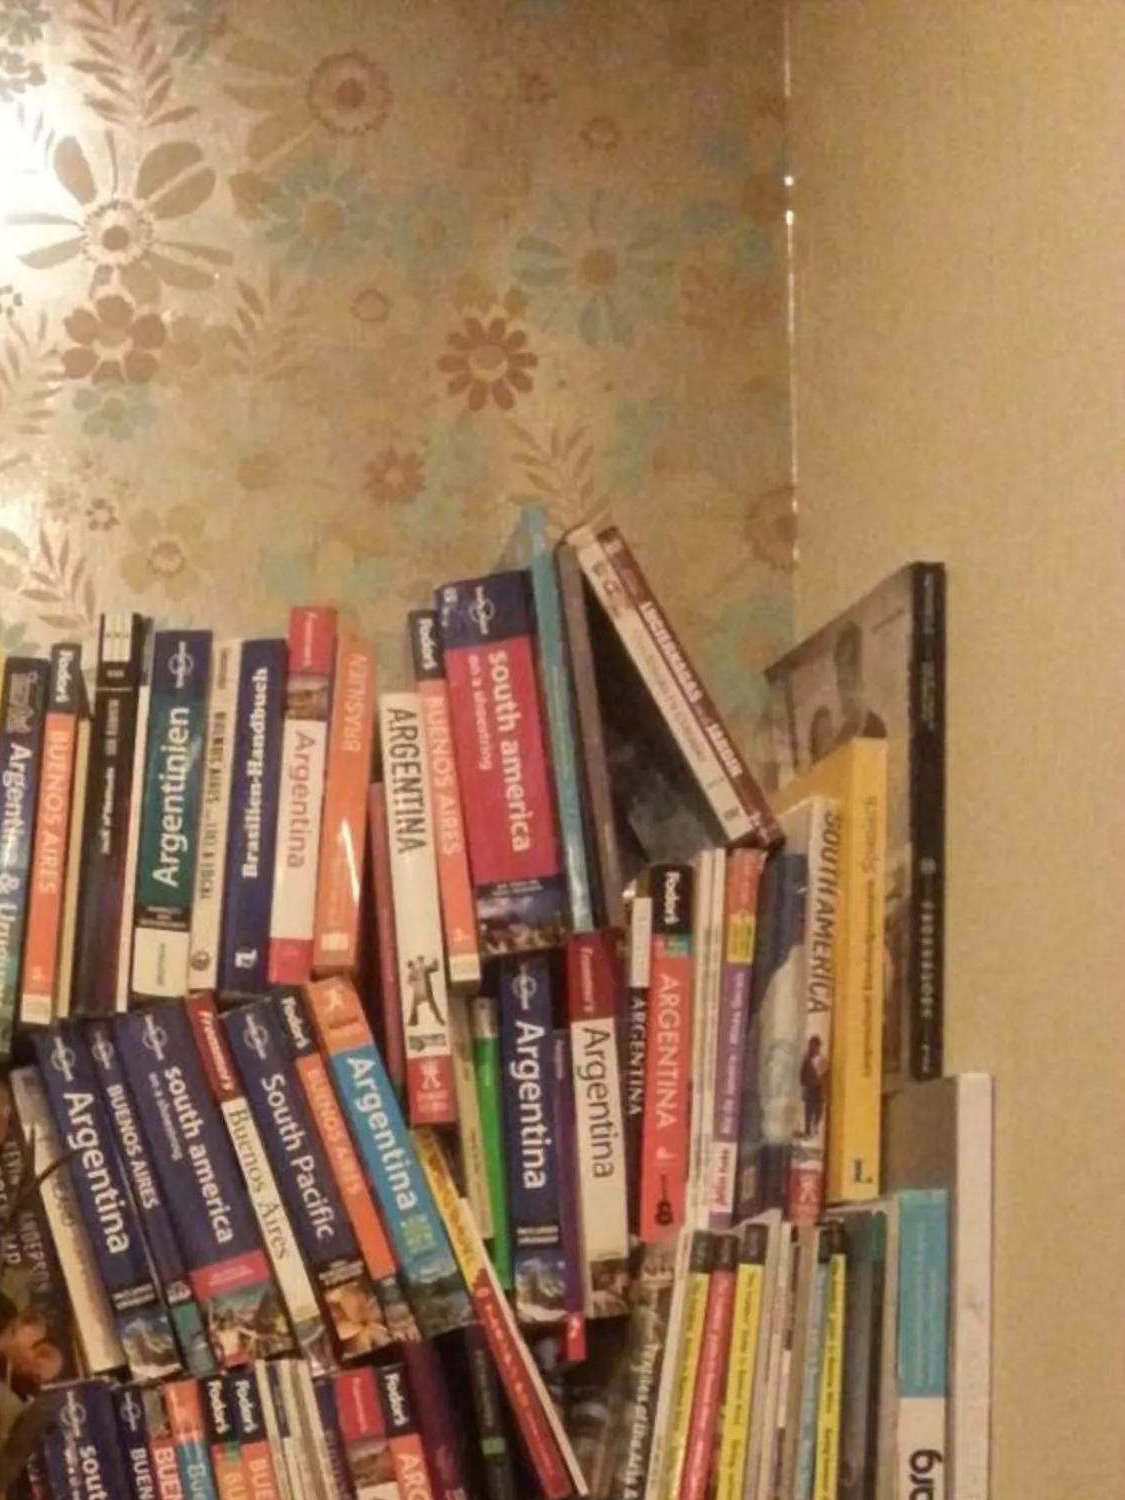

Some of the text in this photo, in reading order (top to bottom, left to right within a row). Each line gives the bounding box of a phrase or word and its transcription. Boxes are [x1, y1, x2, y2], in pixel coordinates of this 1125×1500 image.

[242, 669, 268, 881] Brasilien-Handbuch
[341, 653, 368, 753] BRASILIEN
[427, 697, 462, 856] BUENOS AIRES
[487, 650, 537, 852] south america
[38, 729, 70, 895] BUENOS AIRES
[152, 708, 192, 887] Argentinien
[284, 731, 316, 870] Argentina
[387, 708, 427, 854] ARGENTINA
[806, 811, 844, 1014] SOUTH AMERICA
[510, 1019, 552, 1189] Argentina
[577, 1026, 617, 1178] Argentina
[628, 995, 646, 1115] ARGENTINA
[656, 971, 681, 1130] ARGENTINA
[62, 1091, 131, 1255] Argentina
[108, 1084, 160, 1210] BUENOS AIRES
[161, 1065, 236, 1243] south america
[226, 1106, 268, 1194] Buenos
[259, 1201, 291, 1261] Aires
[259, 1073, 340, 1240] South Pacific
[306, 1067, 345, 1144] BUENOS
[329, 1146, 365, 1197] AIRES
[346, 1056, 423, 1211] Argentina
[207, 1380, 227, 1433] Fodor's
[234, 1380, 257, 1433] Fodor's
[385, 1373, 410, 1426] Fodor's
[635, 1343, 657, 1402] Textiles
[621, 1488, 637, 1500] &
[622, 1452, 643, 1485] Arts
